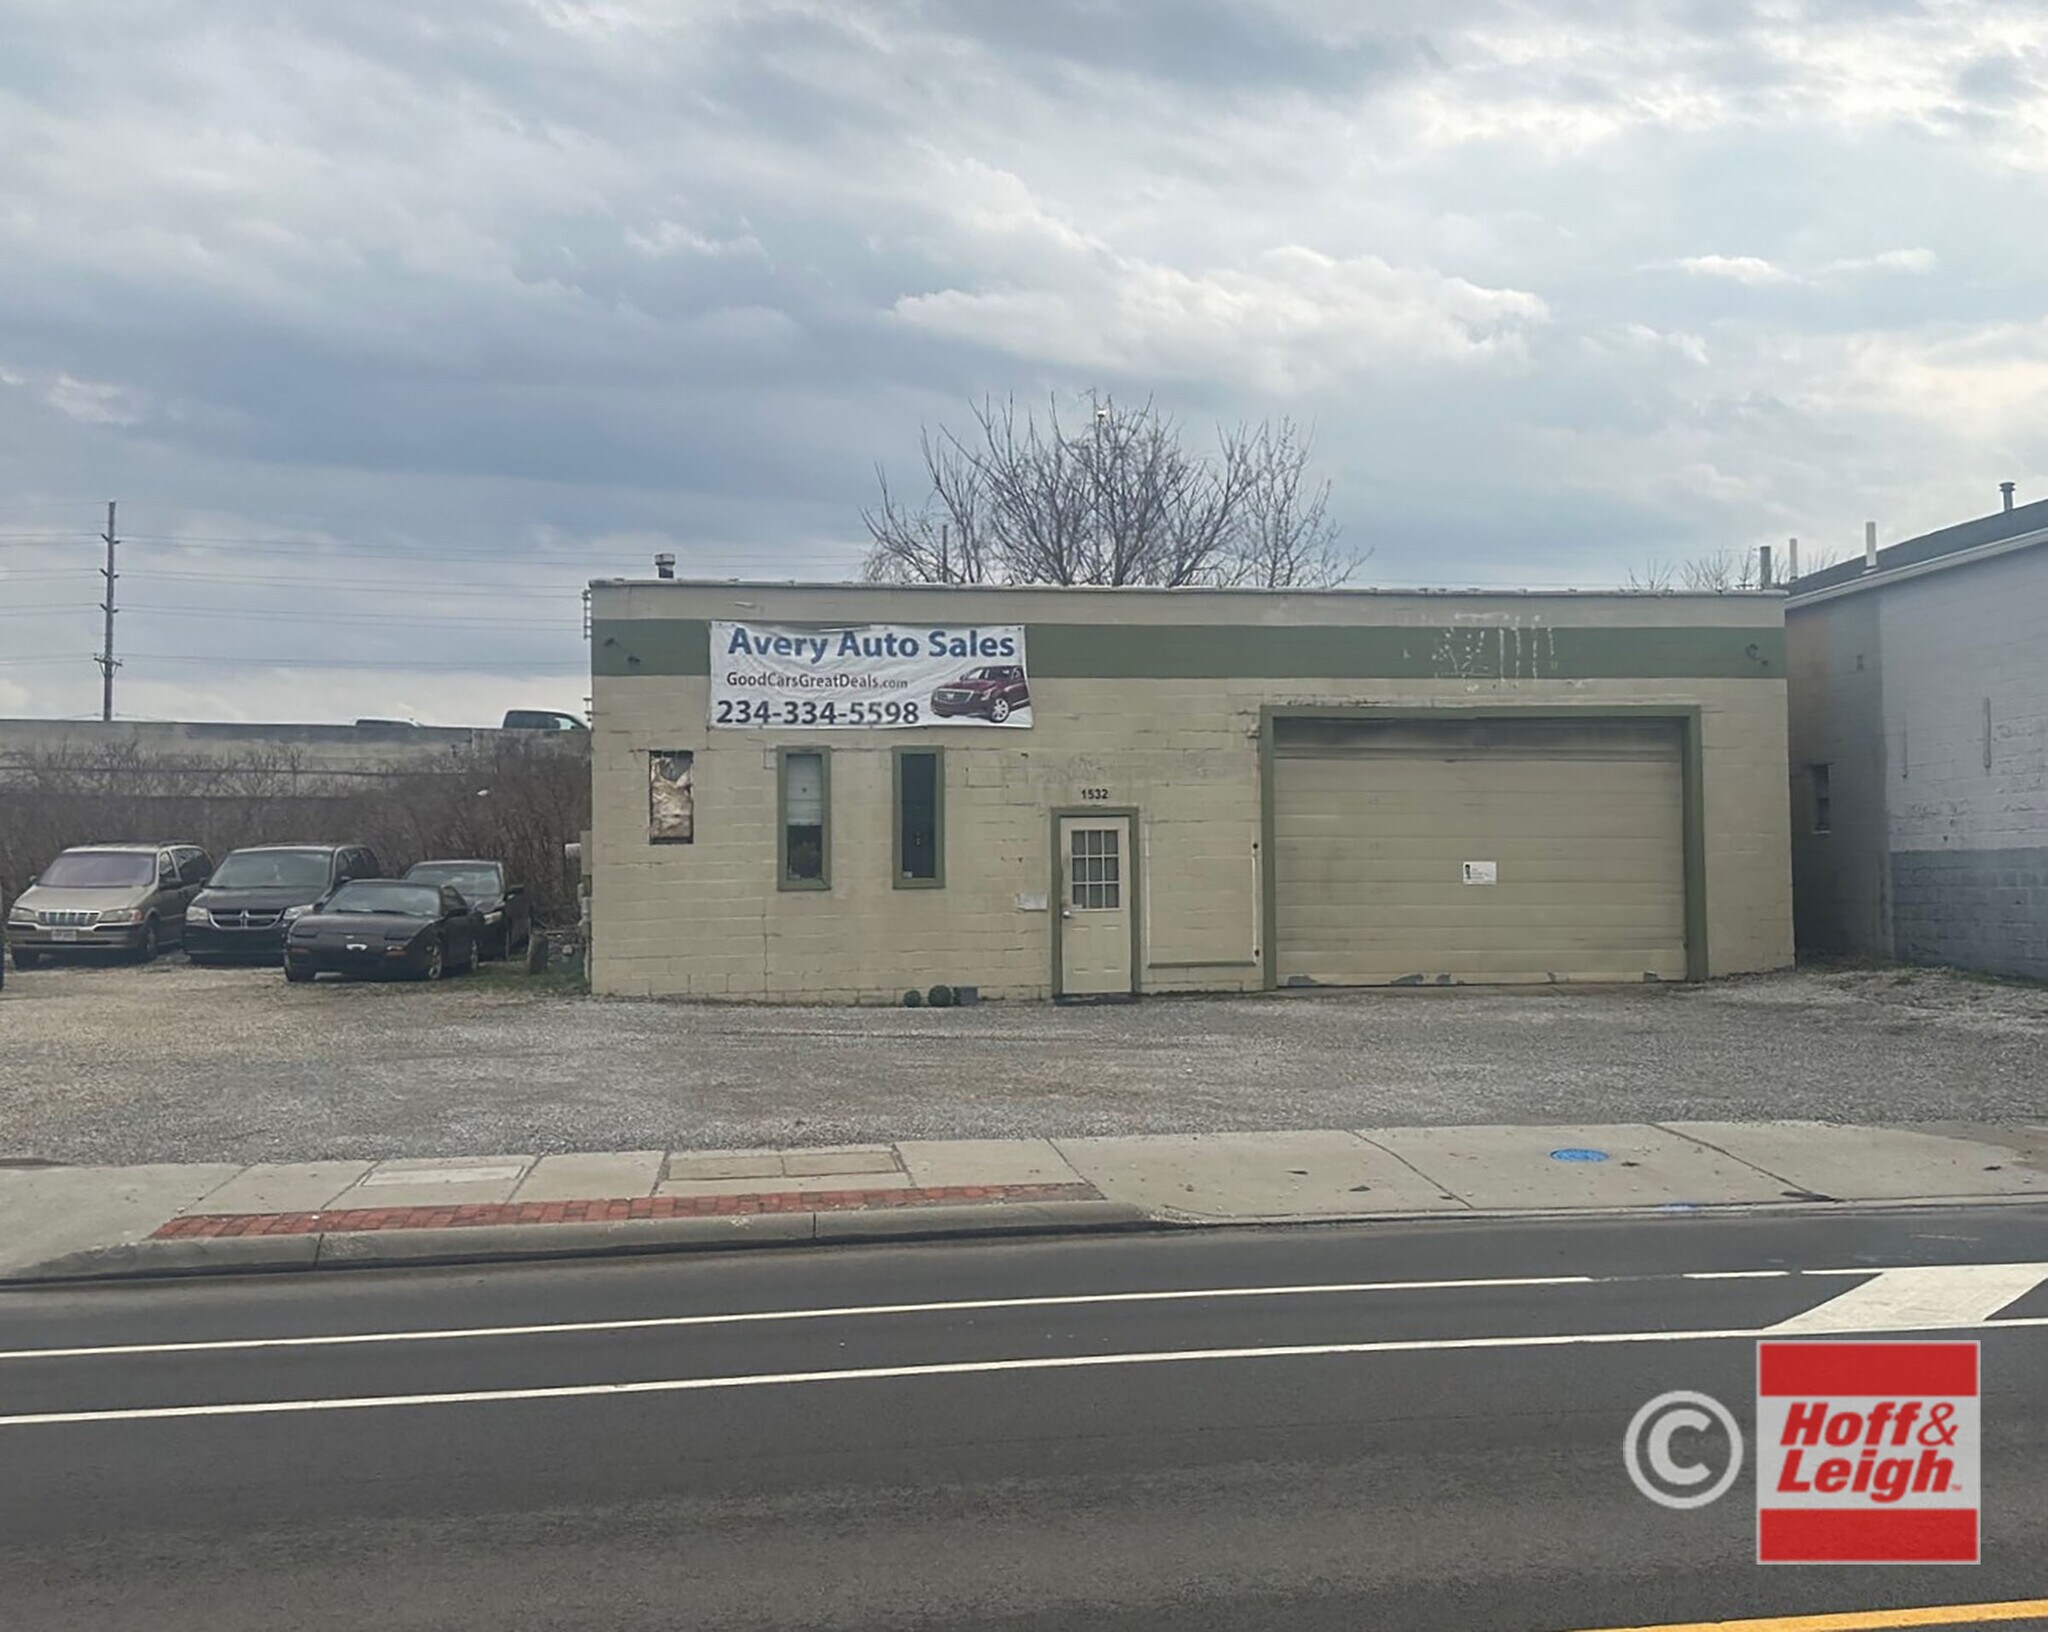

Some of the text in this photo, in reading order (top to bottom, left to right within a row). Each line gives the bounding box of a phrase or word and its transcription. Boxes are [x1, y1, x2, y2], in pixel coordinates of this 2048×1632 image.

[728, 628, 1015, 663] Avery Auto Sales
[726, 672, 908, 689] GoodCarsGreatDeals.com
[716, 700, 919, 724] 234-334-5598
[1081, 789, 1109, 799] 1532
